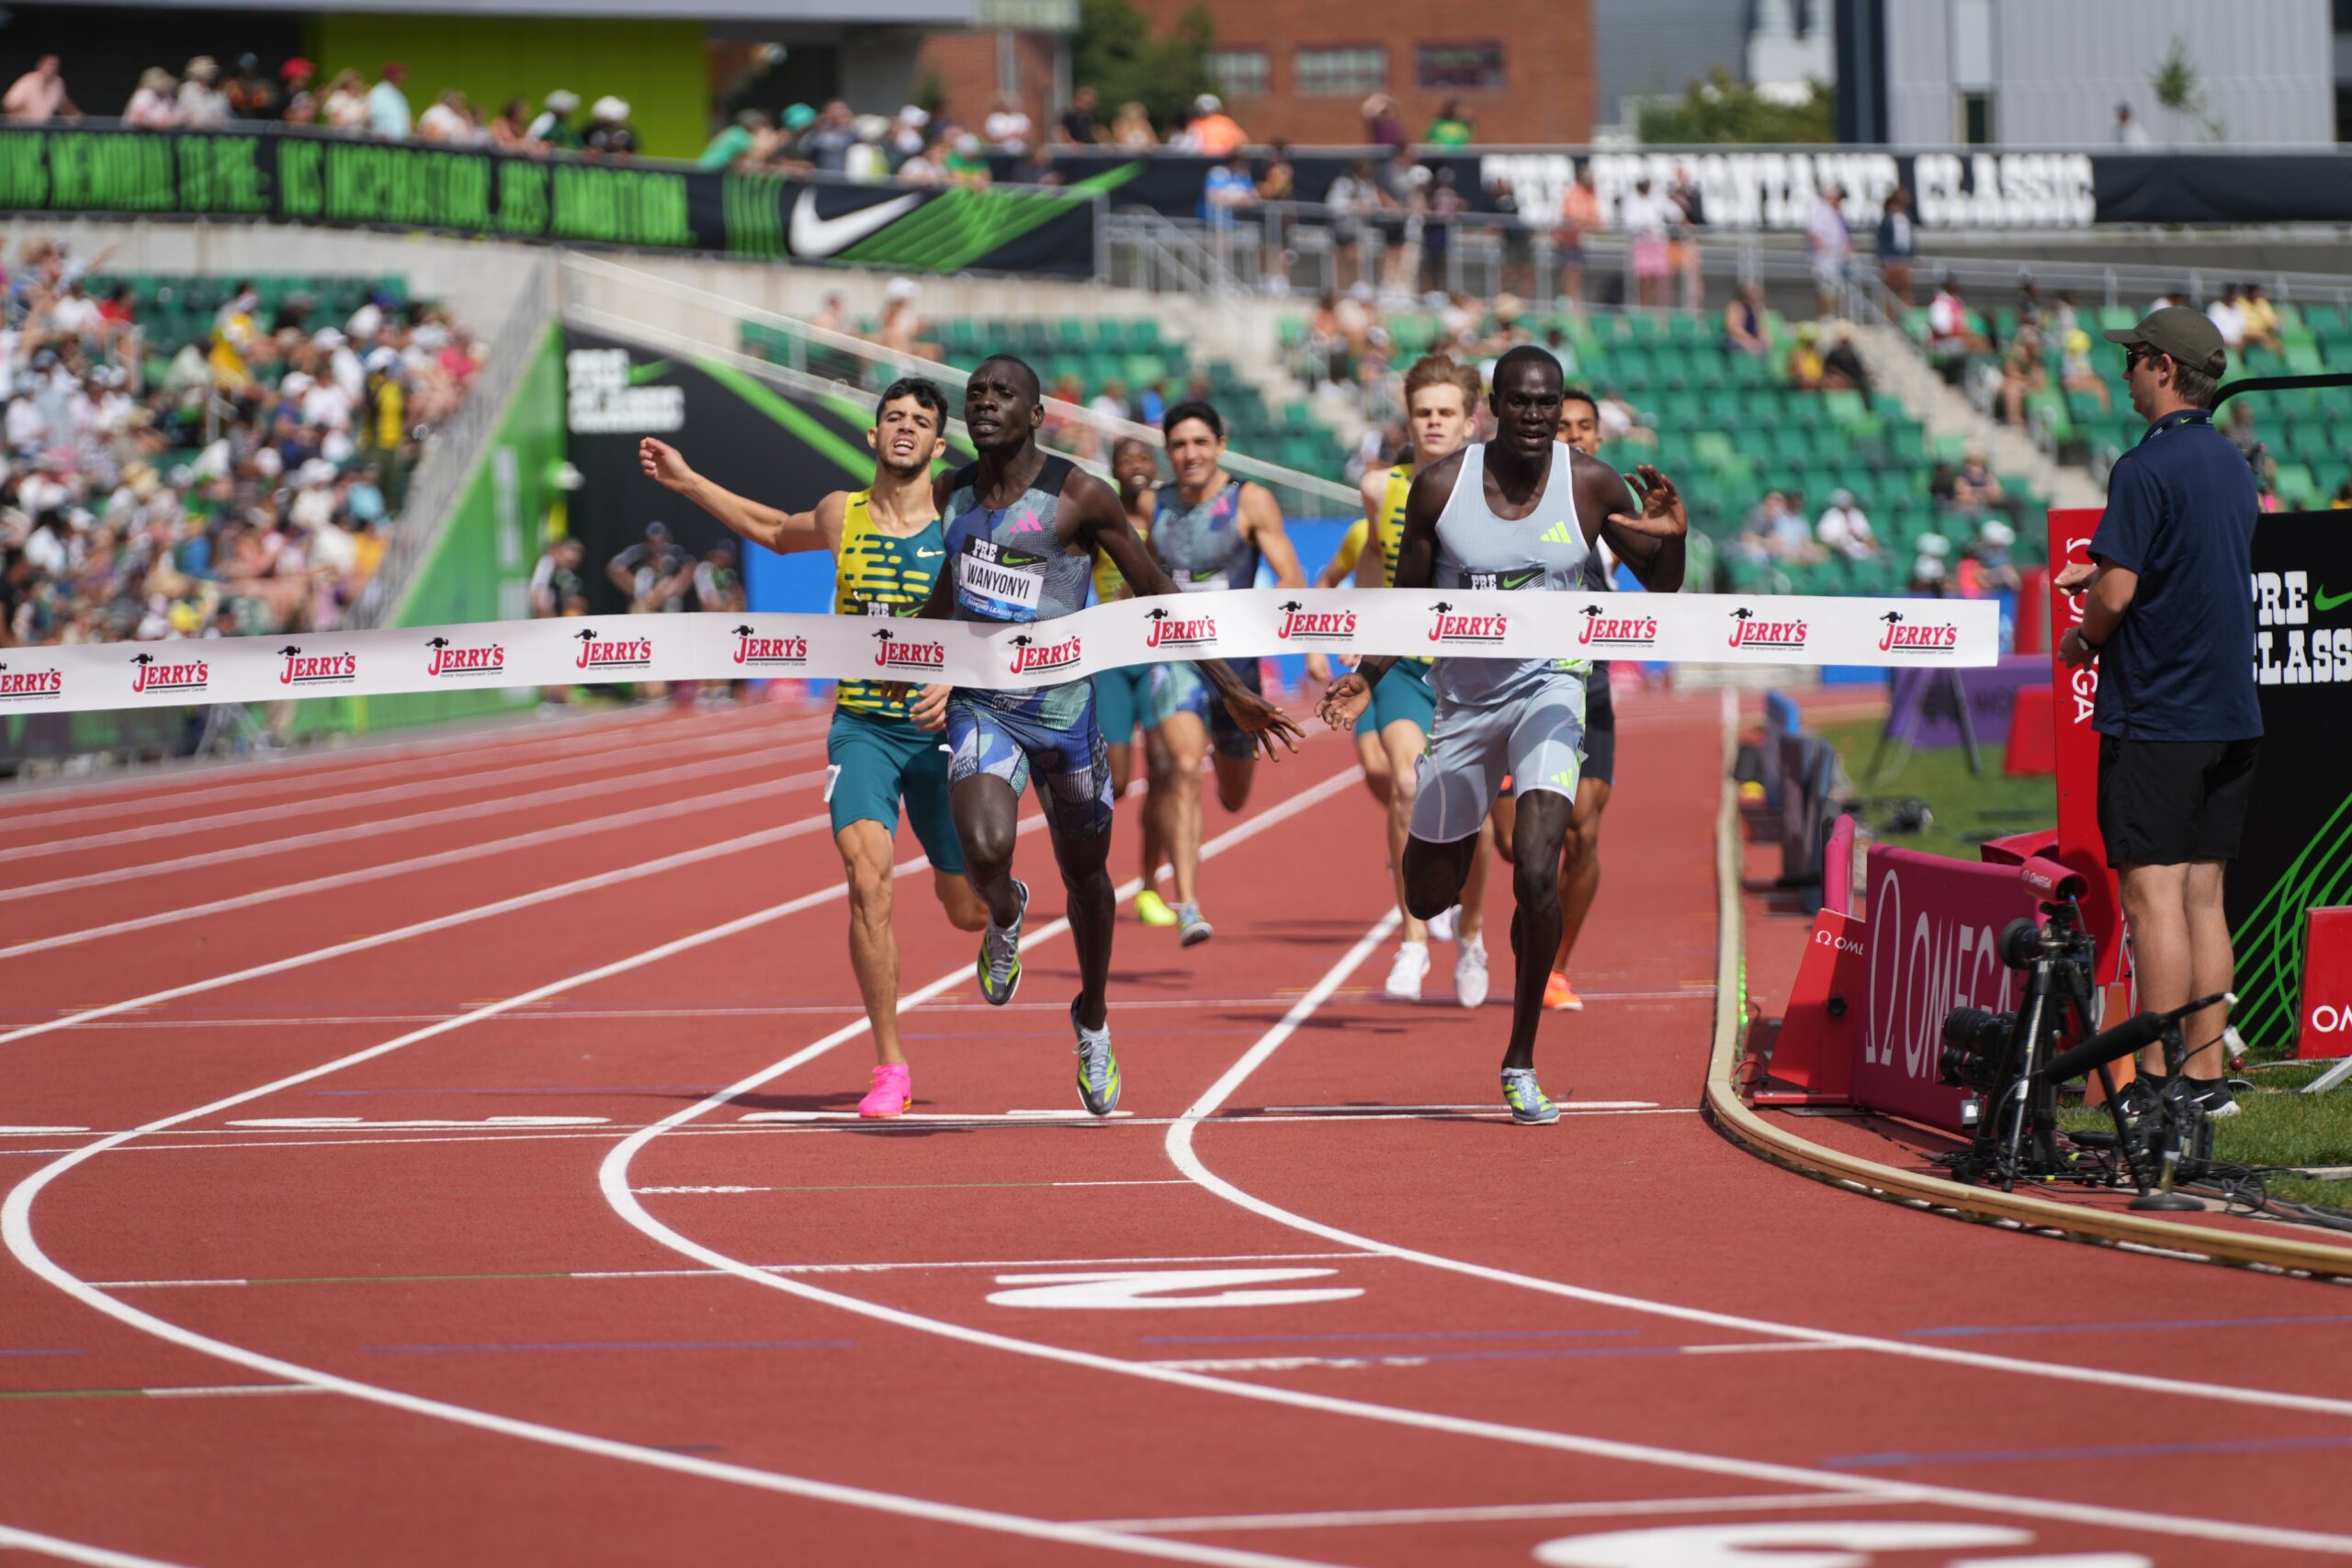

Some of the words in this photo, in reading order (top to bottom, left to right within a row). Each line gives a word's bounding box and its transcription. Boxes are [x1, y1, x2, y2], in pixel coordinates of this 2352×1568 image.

[1914, 152, 2096, 227] CLASSIC
[972, 538, 998, 562] PRE
[967, 563, 1030, 600] WANYONYI
[1471, 574, 1497, 590] PRE
[866, 602, 889, 617] PRE
[1146, 617, 1216, 648] JERRY'S
[1278, 612, 1356, 639] JERRY'S
[1428, 613, 1507, 641] JERRY'S
[1577, 616, 1657, 645] JERRY'S
[1728, 619, 1807, 648] JERRY'S
[1878, 623, 1957, 651] JERRY'S
[427, 646, 504, 676] JERRY'S
[575, 638, 653, 669] JERRY'S
[734, 636, 808, 664] JERRY'S
[875, 641, 944, 666] JERRY'S
[1010, 636, 1081, 674] JERRY'S
[2253, 627, 2352, 685] LASS
[0, 669, 62, 693] ERRY'S
[133, 661, 209, 692] JERRY'S
[280, 653, 356, 684] JERRY'S
